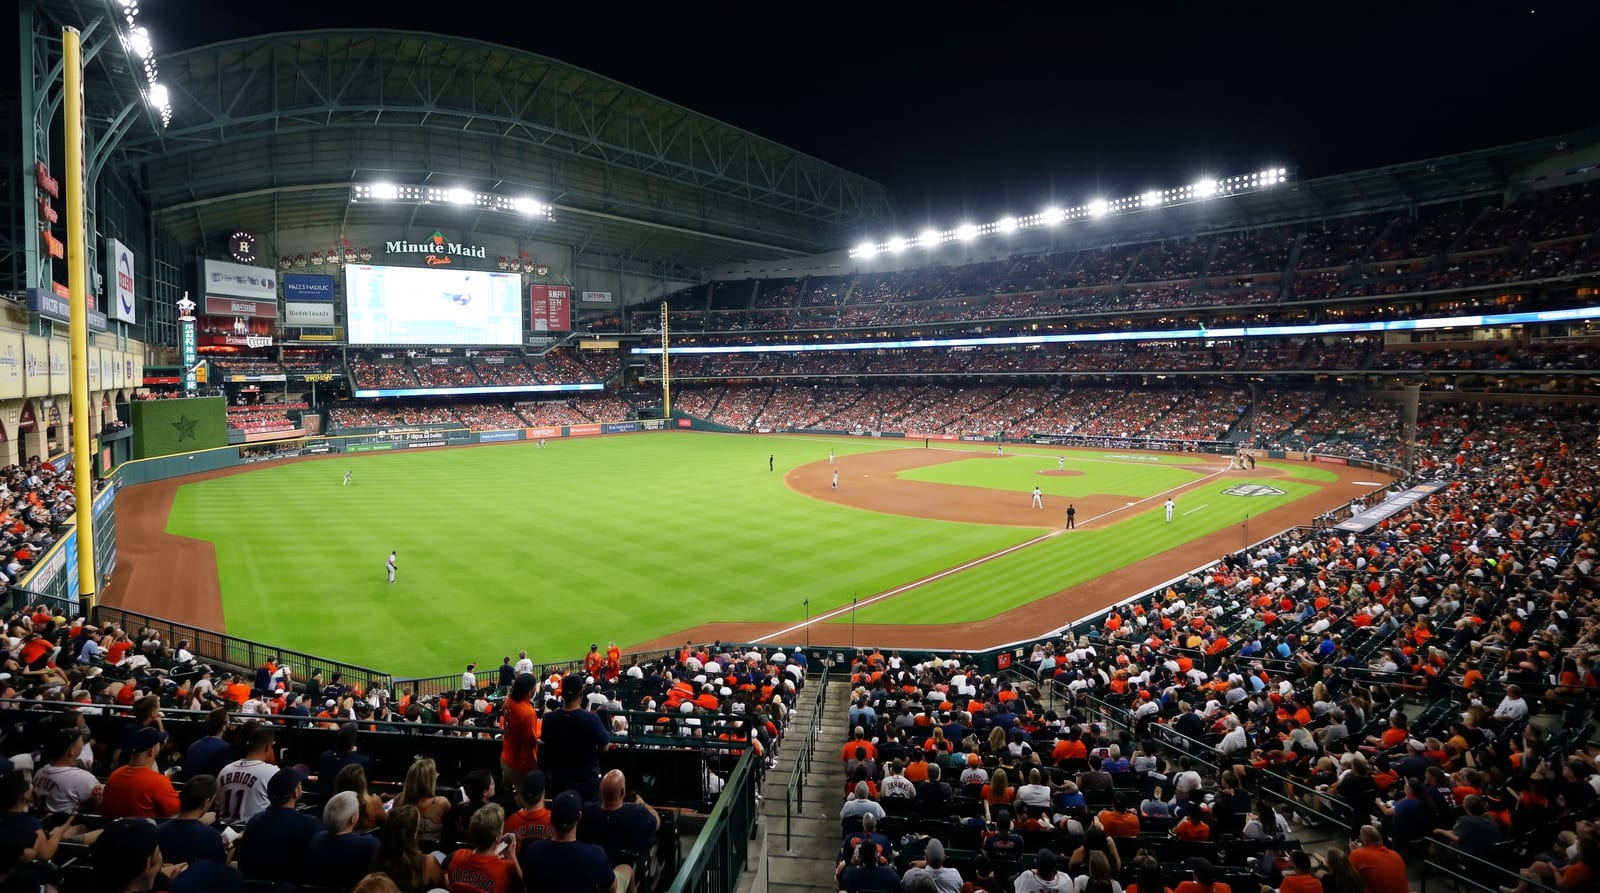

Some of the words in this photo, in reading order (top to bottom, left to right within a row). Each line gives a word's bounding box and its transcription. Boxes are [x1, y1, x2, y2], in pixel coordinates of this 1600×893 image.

[386, 240, 444, 253] Minute
[448, 243, 486, 259] Maid
[221, 789, 245, 819] 11
